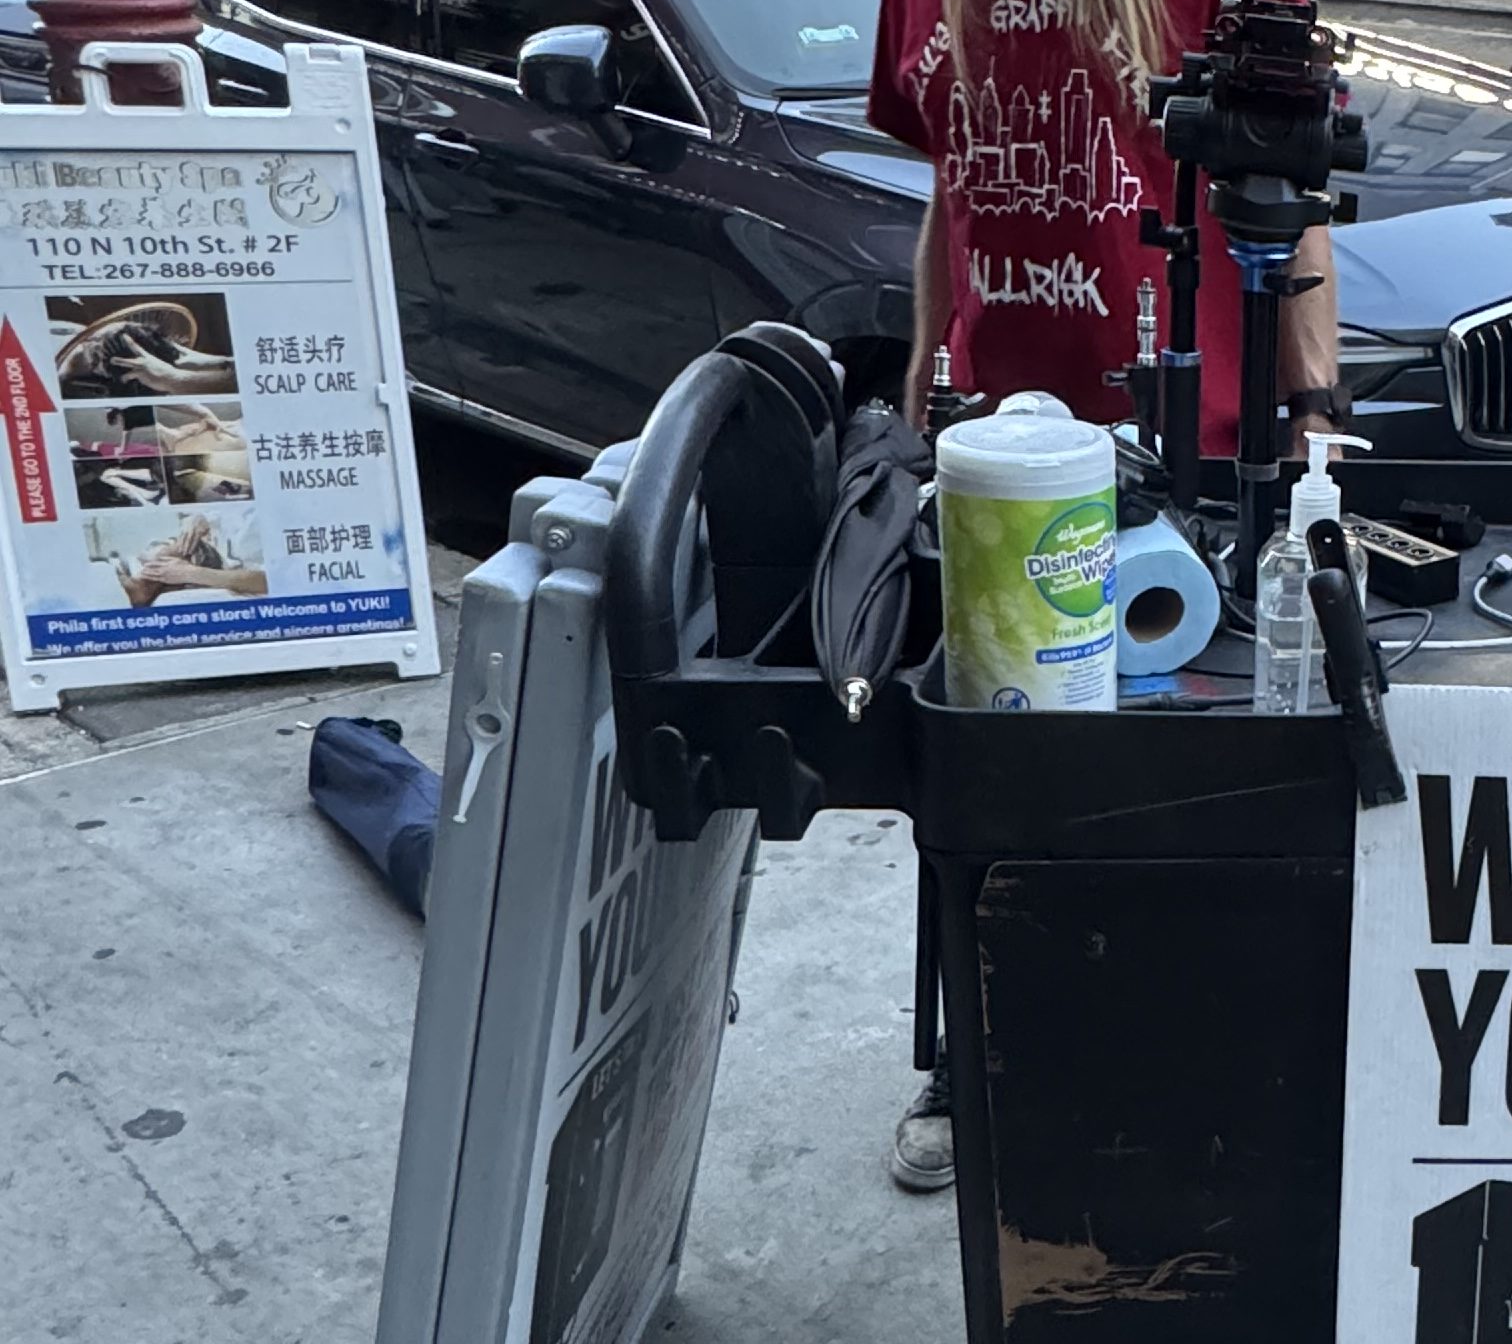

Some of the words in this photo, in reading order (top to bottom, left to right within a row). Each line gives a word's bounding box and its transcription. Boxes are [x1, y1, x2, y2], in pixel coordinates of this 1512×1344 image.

[26, 236, 82, 257] 110
[91, 236, 113, 256] N
[122, 235, 190, 256] 10th
[198, 234, 235, 255] St.
[243, 235, 258, 254] #
[266, 234, 300, 253] 2F
[969, 247, 1110, 318] ALLRISK
[255, 334, 346, 365] 舒适头疗
[5, 358, 25, 396] FLOOR
[254, 373, 306, 395] SCALP
[314, 372, 358, 392] CARE
[13, 396, 30, 419] 2ND
[17, 419, 33, 442] THE
[21, 441, 36, 459] TO
[252, 428, 387, 462] 古法养生按摩
[24, 458, 39, 476] GO
[279, 467, 359, 490] MASSAGE
[26, 477, 48, 518] PLEASE
[282, 523, 374, 555] 面部护理
[308, 560, 366, 583] FACIAL
[47, 619, 90, 635] Phila
[90, 617, 124, 632] first
[126, 612, 169, 631] scalp
[171, 610, 208, 626] care
[211, 605, 256, 624] store!
[258, 601, 328, 620] Welcome
[330, 600, 347, 613] to
[347, 595, 391, 613] YUKI!
[1052, 622, 1087, 641] Fresh
